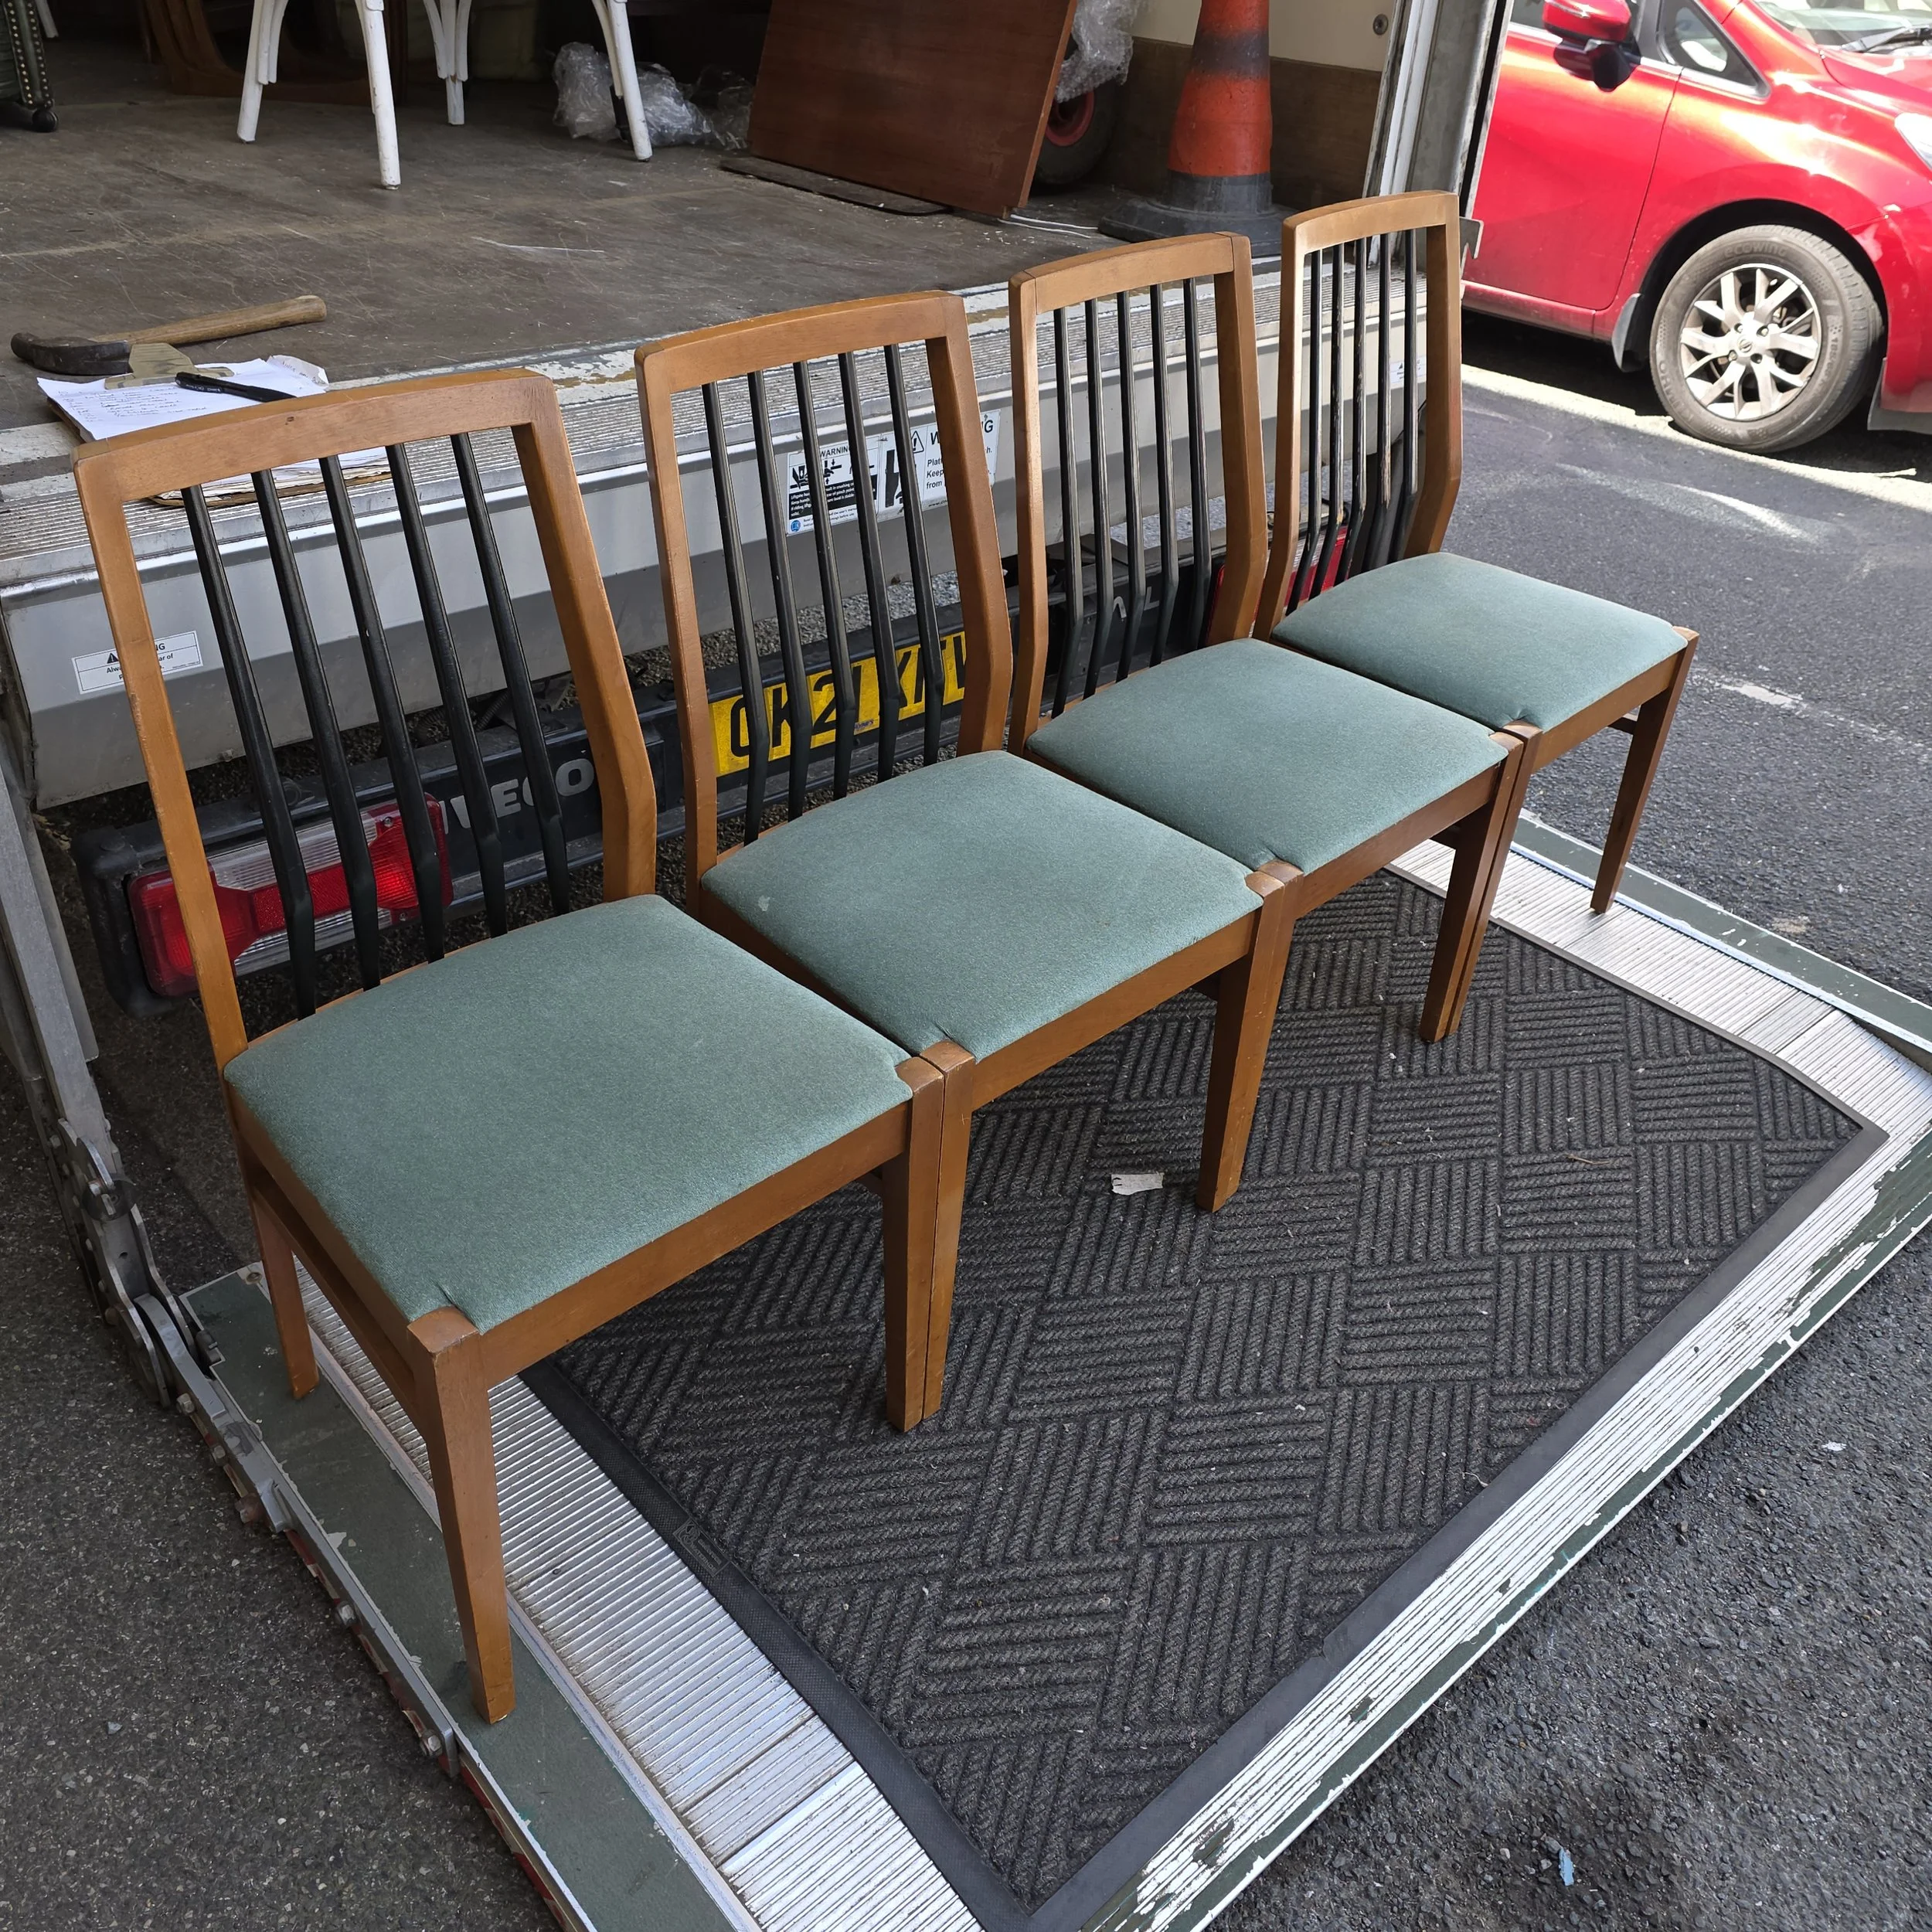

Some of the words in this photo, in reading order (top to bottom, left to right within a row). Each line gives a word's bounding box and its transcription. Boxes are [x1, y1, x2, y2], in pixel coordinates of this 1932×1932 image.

[820, 445, 849, 457] WARNIN
[927, 457, 942, 467] Plat
[927, 469, 944, 478] Keep
[927, 481, 942, 489] from
